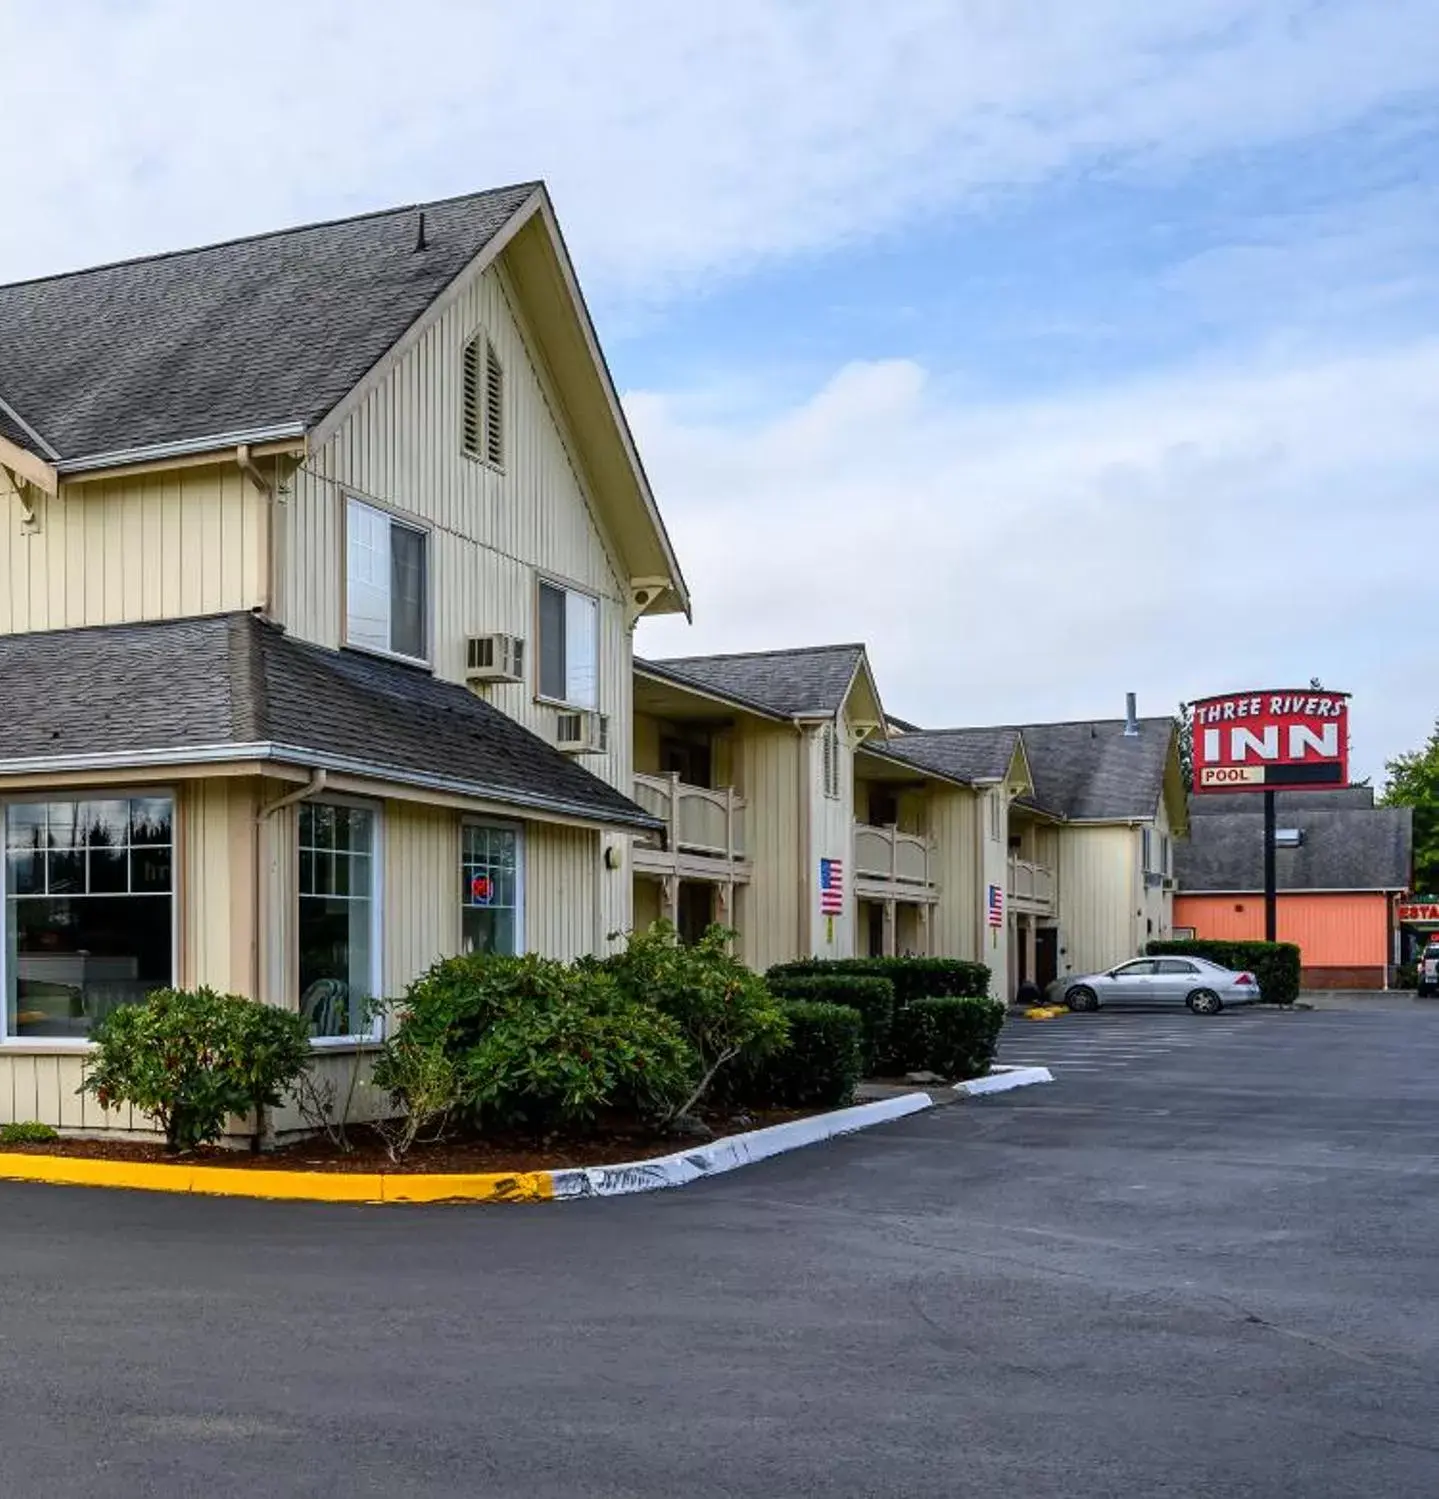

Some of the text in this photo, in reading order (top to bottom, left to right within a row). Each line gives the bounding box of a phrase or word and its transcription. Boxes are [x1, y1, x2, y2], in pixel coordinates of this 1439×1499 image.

[1197, 696, 1344, 724] THREE RIVERS
[1204, 723, 1338, 762] INN
[1206, 769, 1248, 781] POOL
